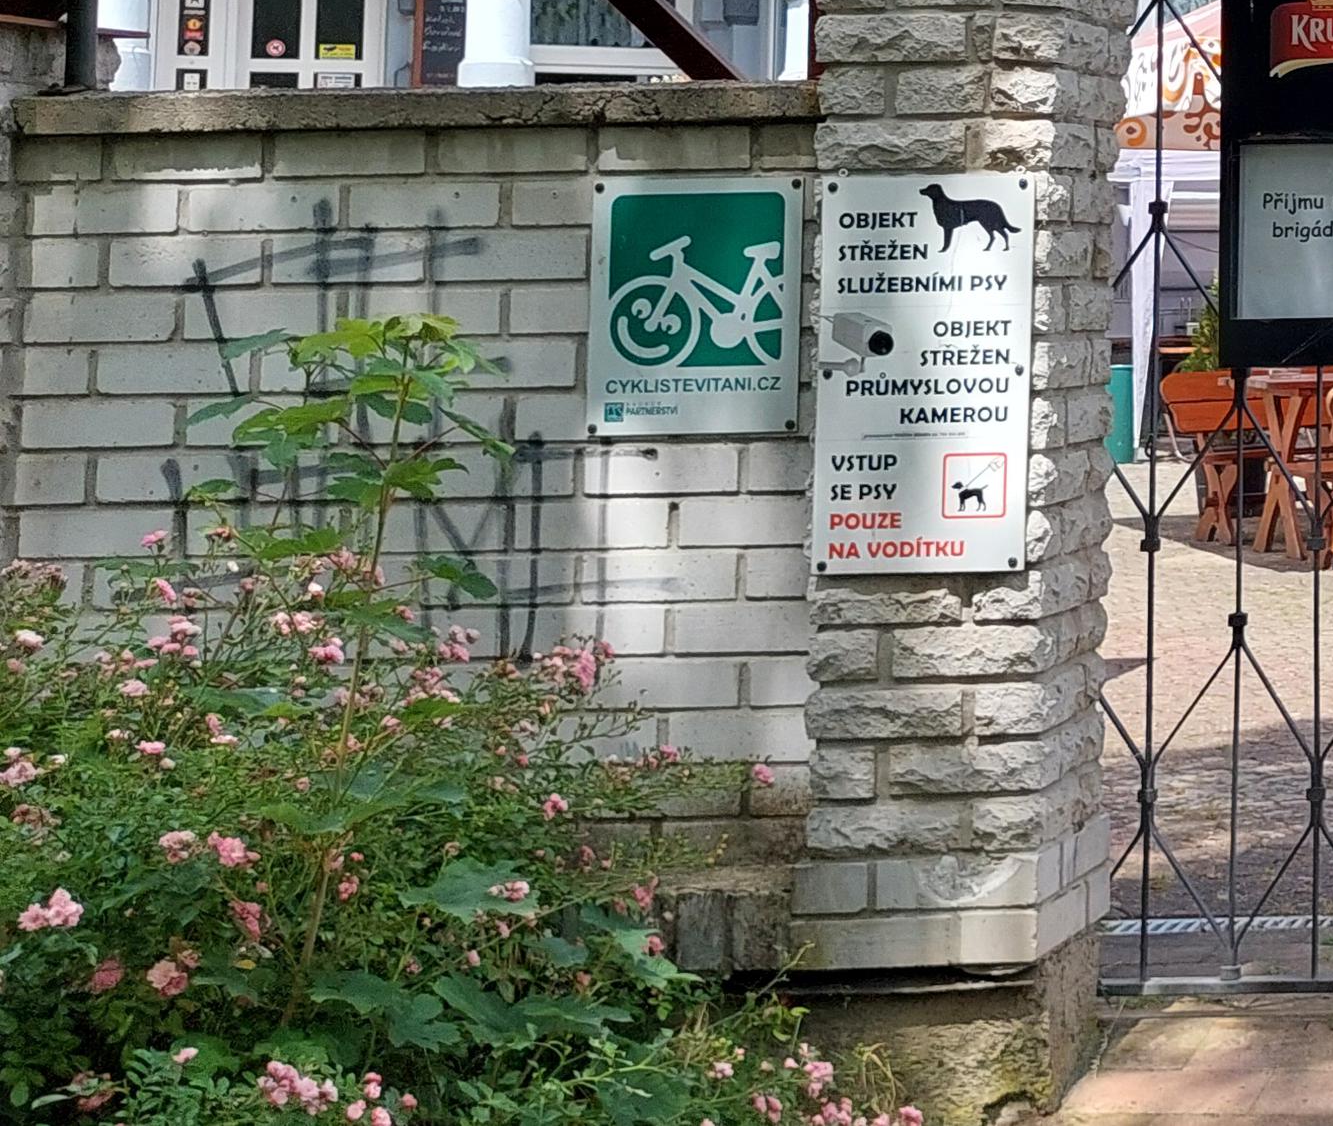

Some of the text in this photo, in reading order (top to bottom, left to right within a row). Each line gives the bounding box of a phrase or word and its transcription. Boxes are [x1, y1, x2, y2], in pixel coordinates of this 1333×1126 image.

[839, 211, 918, 229] OBJEKT
[838, 240, 928, 262] STŘEŽEN
[837, 274, 1008, 294] SLUŽEBNÍMI PSY
[933, 320, 1012, 338] OBJEKT
[920, 345, 1010, 367] STŘEŽEN
[605, 376, 782, 394] CYKLISTEVITANI.CZ
[846, 372, 1010, 397] PRŮMYSLOVOU
[900, 407, 1008, 425] KAMEROU
[831, 454, 898, 472] VSTUP
[830, 483, 898, 501] SE PSY
[830, 512, 902, 530] POUZE
[828, 536, 965, 559] NA VODÍTKU
